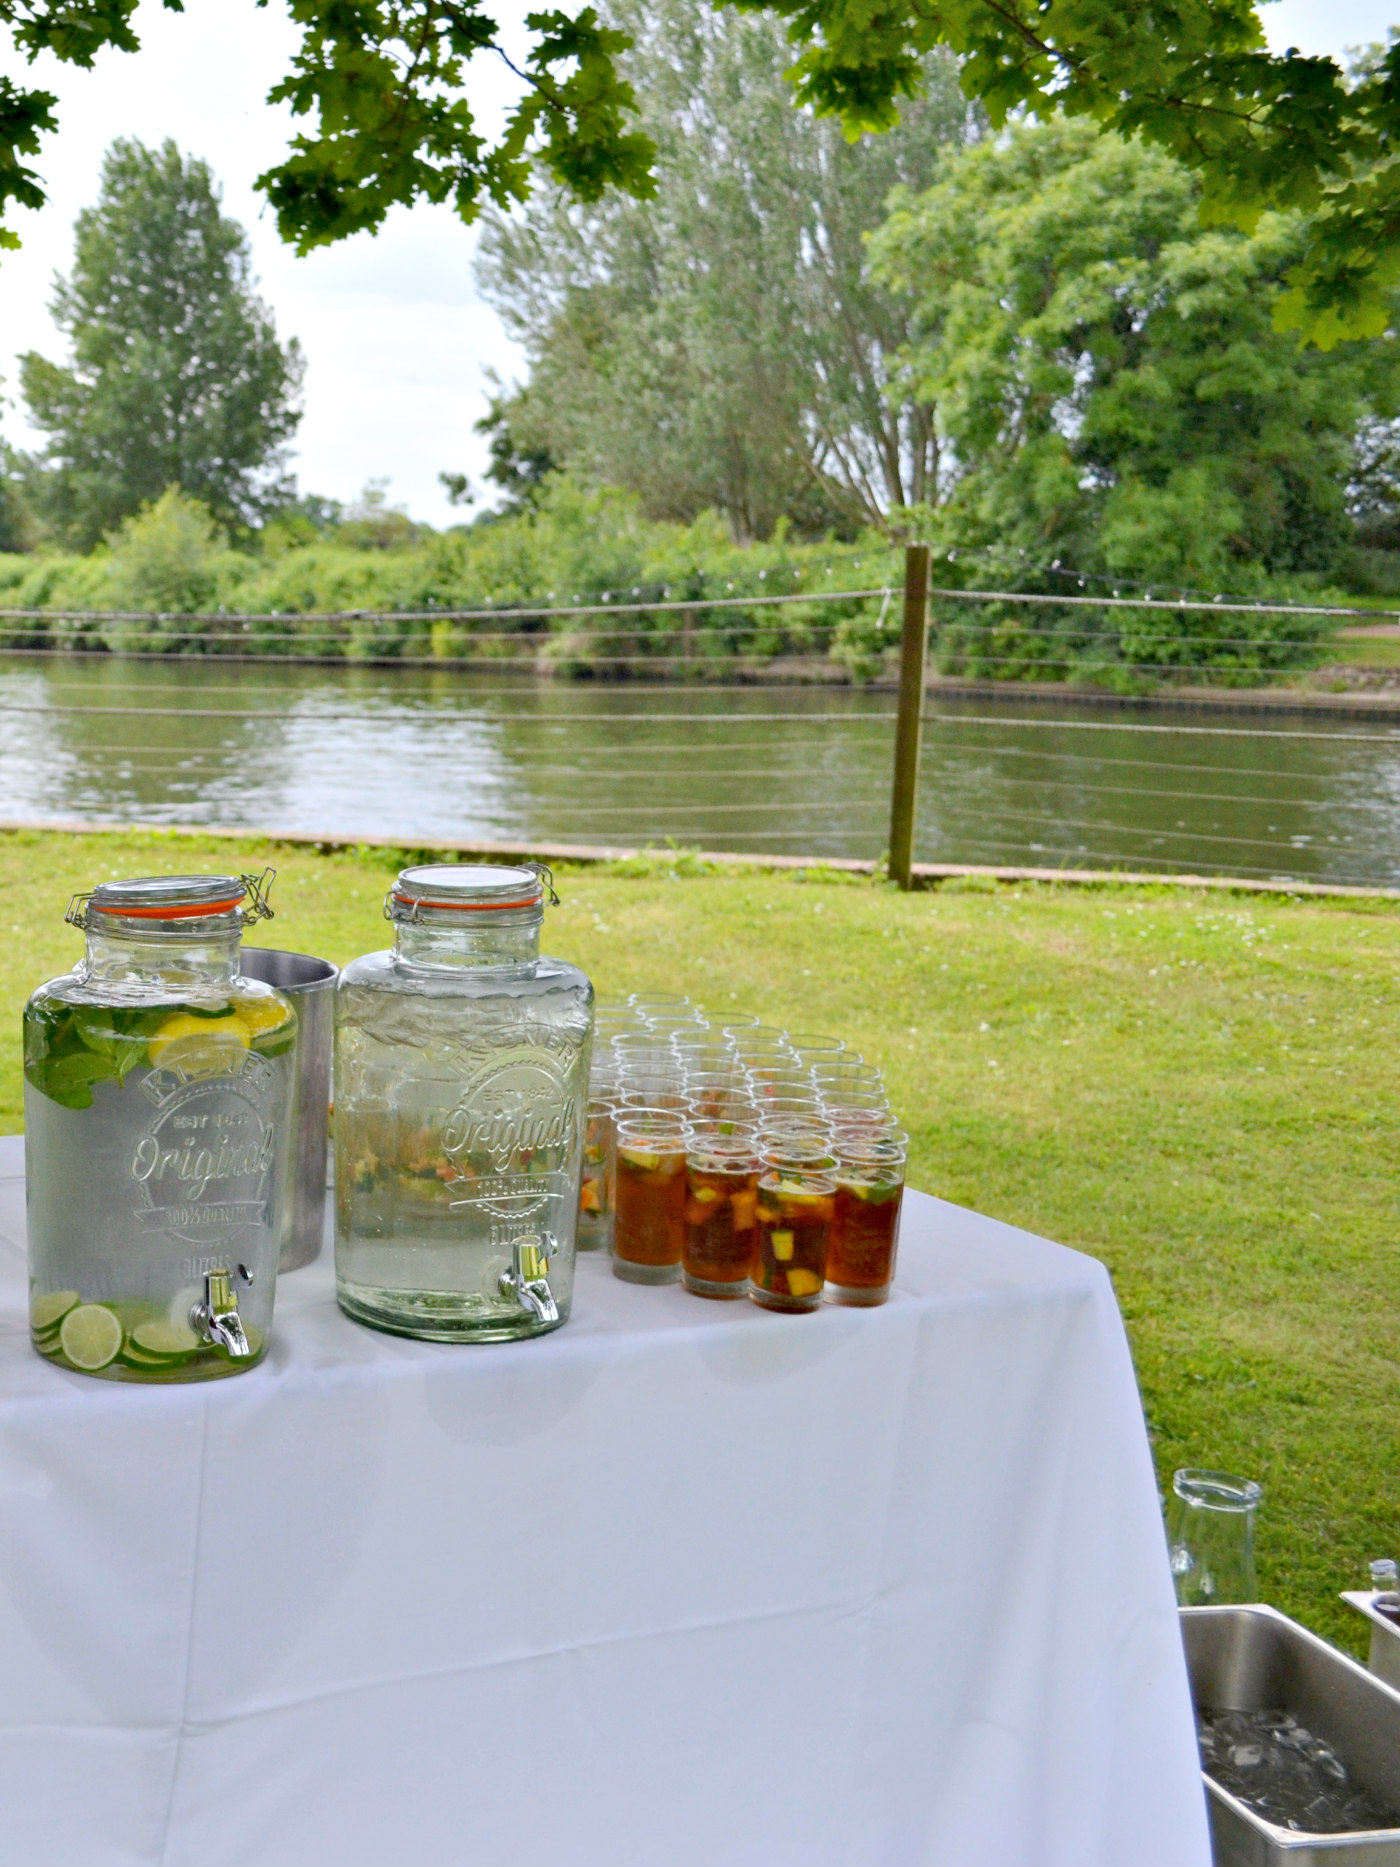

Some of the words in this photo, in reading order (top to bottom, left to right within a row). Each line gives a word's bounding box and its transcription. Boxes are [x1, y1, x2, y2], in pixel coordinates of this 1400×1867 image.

[144, 1050, 269, 1099] KILNER
[483, 1089, 515, 1103] EST
[130, 1123, 274, 1201] Original
[441, 1097, 574, 1171] Original
